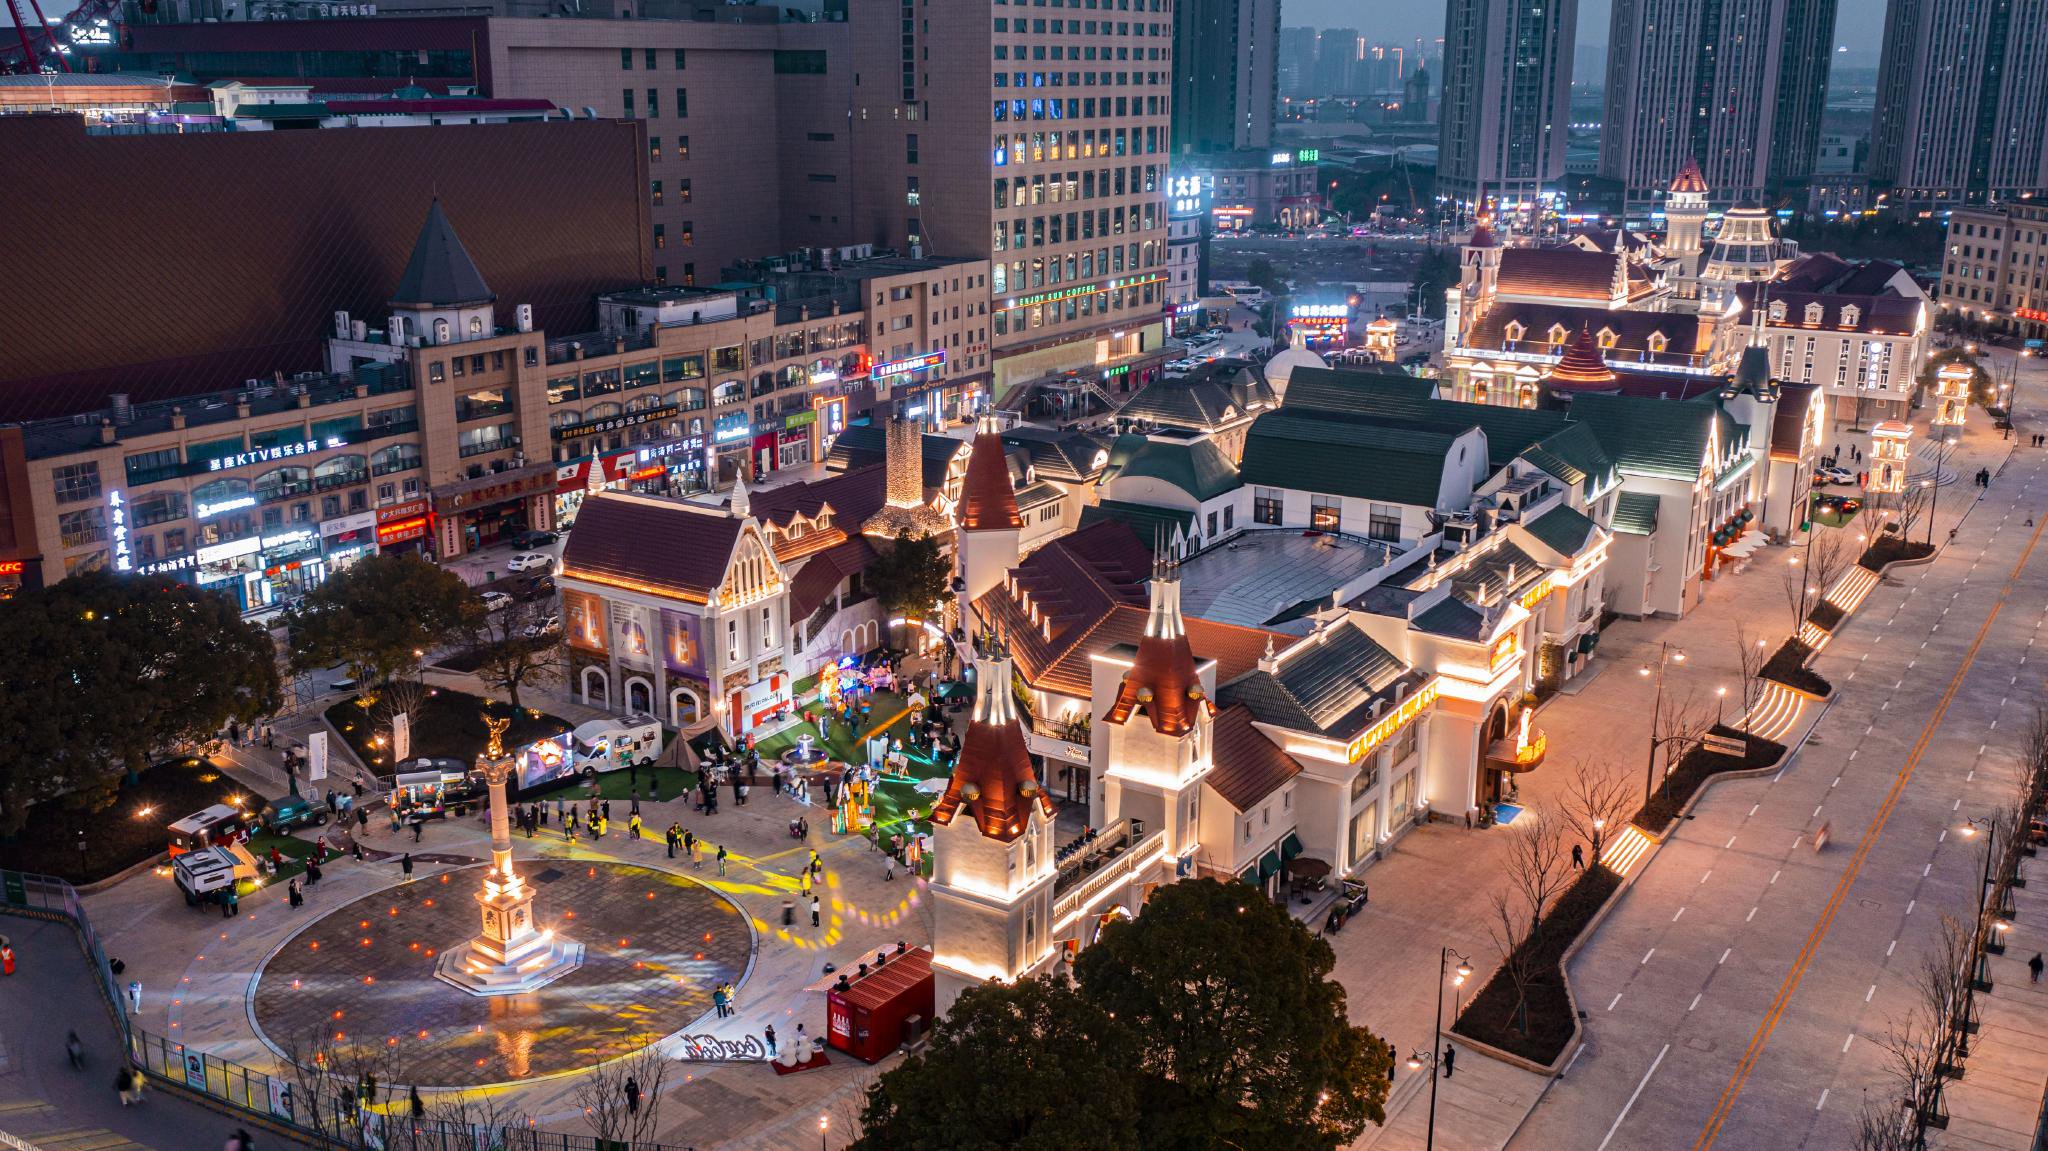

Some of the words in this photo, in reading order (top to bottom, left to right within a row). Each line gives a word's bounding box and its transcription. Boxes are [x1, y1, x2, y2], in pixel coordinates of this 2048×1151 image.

[1019, 295, 1044, 306] ENJOY
[1047, 292, 1063, 301] SUN
[1066, 285, 1096, 297] COFFEE
[209, 440, 318, 471] 星座KTV娱乐会所
